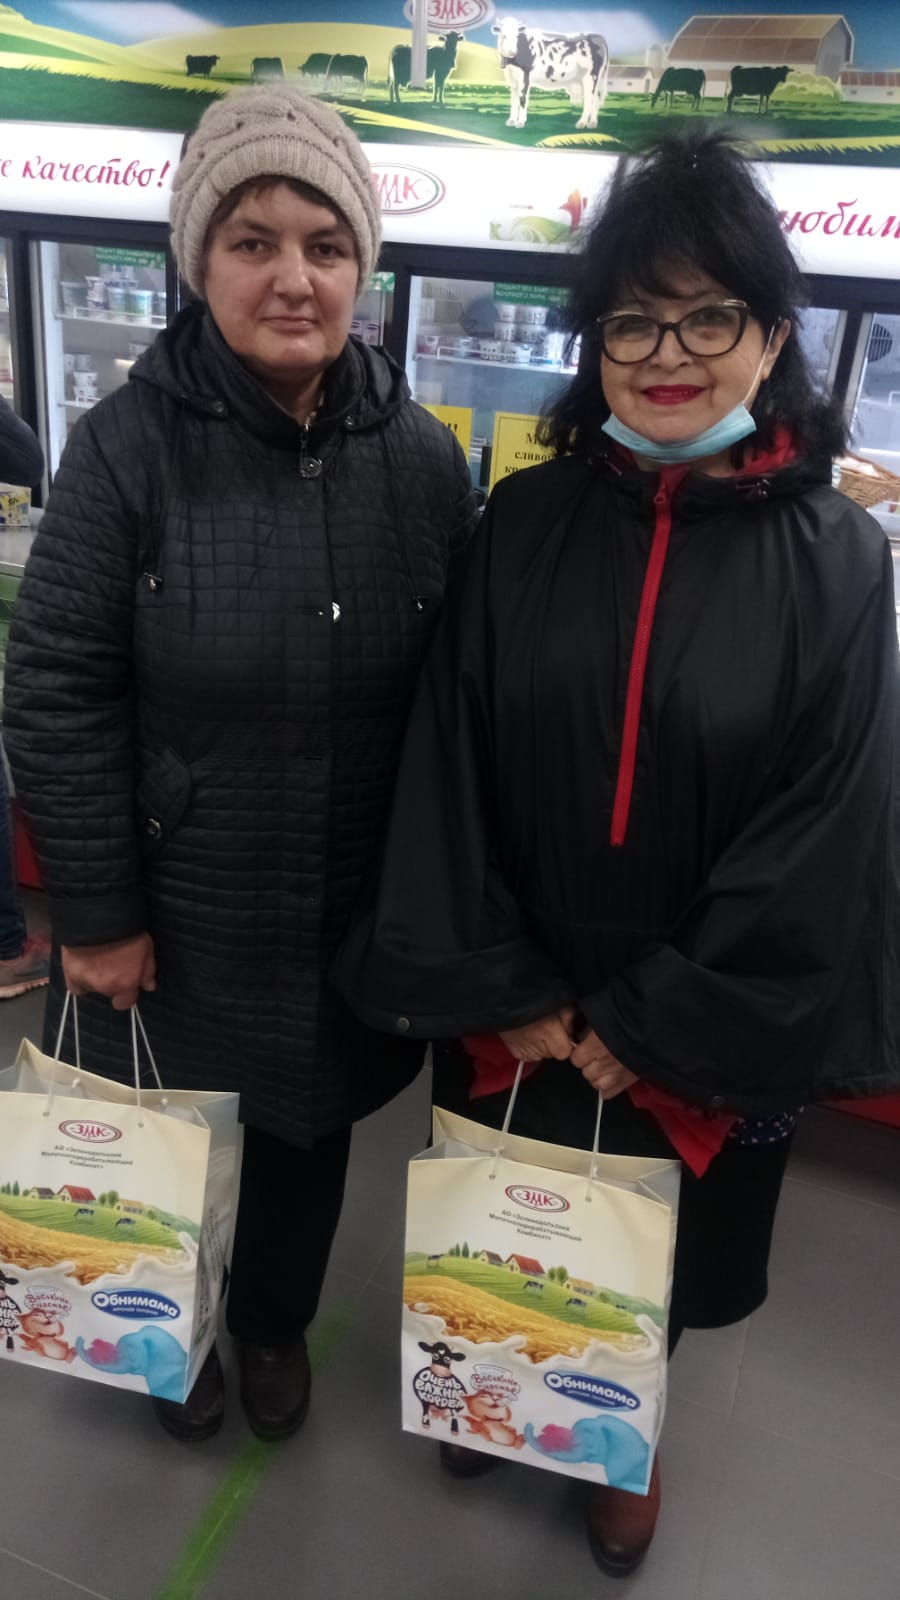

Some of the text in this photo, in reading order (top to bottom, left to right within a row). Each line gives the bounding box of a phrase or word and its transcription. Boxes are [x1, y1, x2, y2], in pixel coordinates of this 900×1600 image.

[519, 1190, 556, 1206] ЗМК
[93, 1292, 178, 1317] Обнимама
[419, 1370, 462, 1389] ОЧЕНЬ
[546, 1373, 637, 1408] Обнимама
